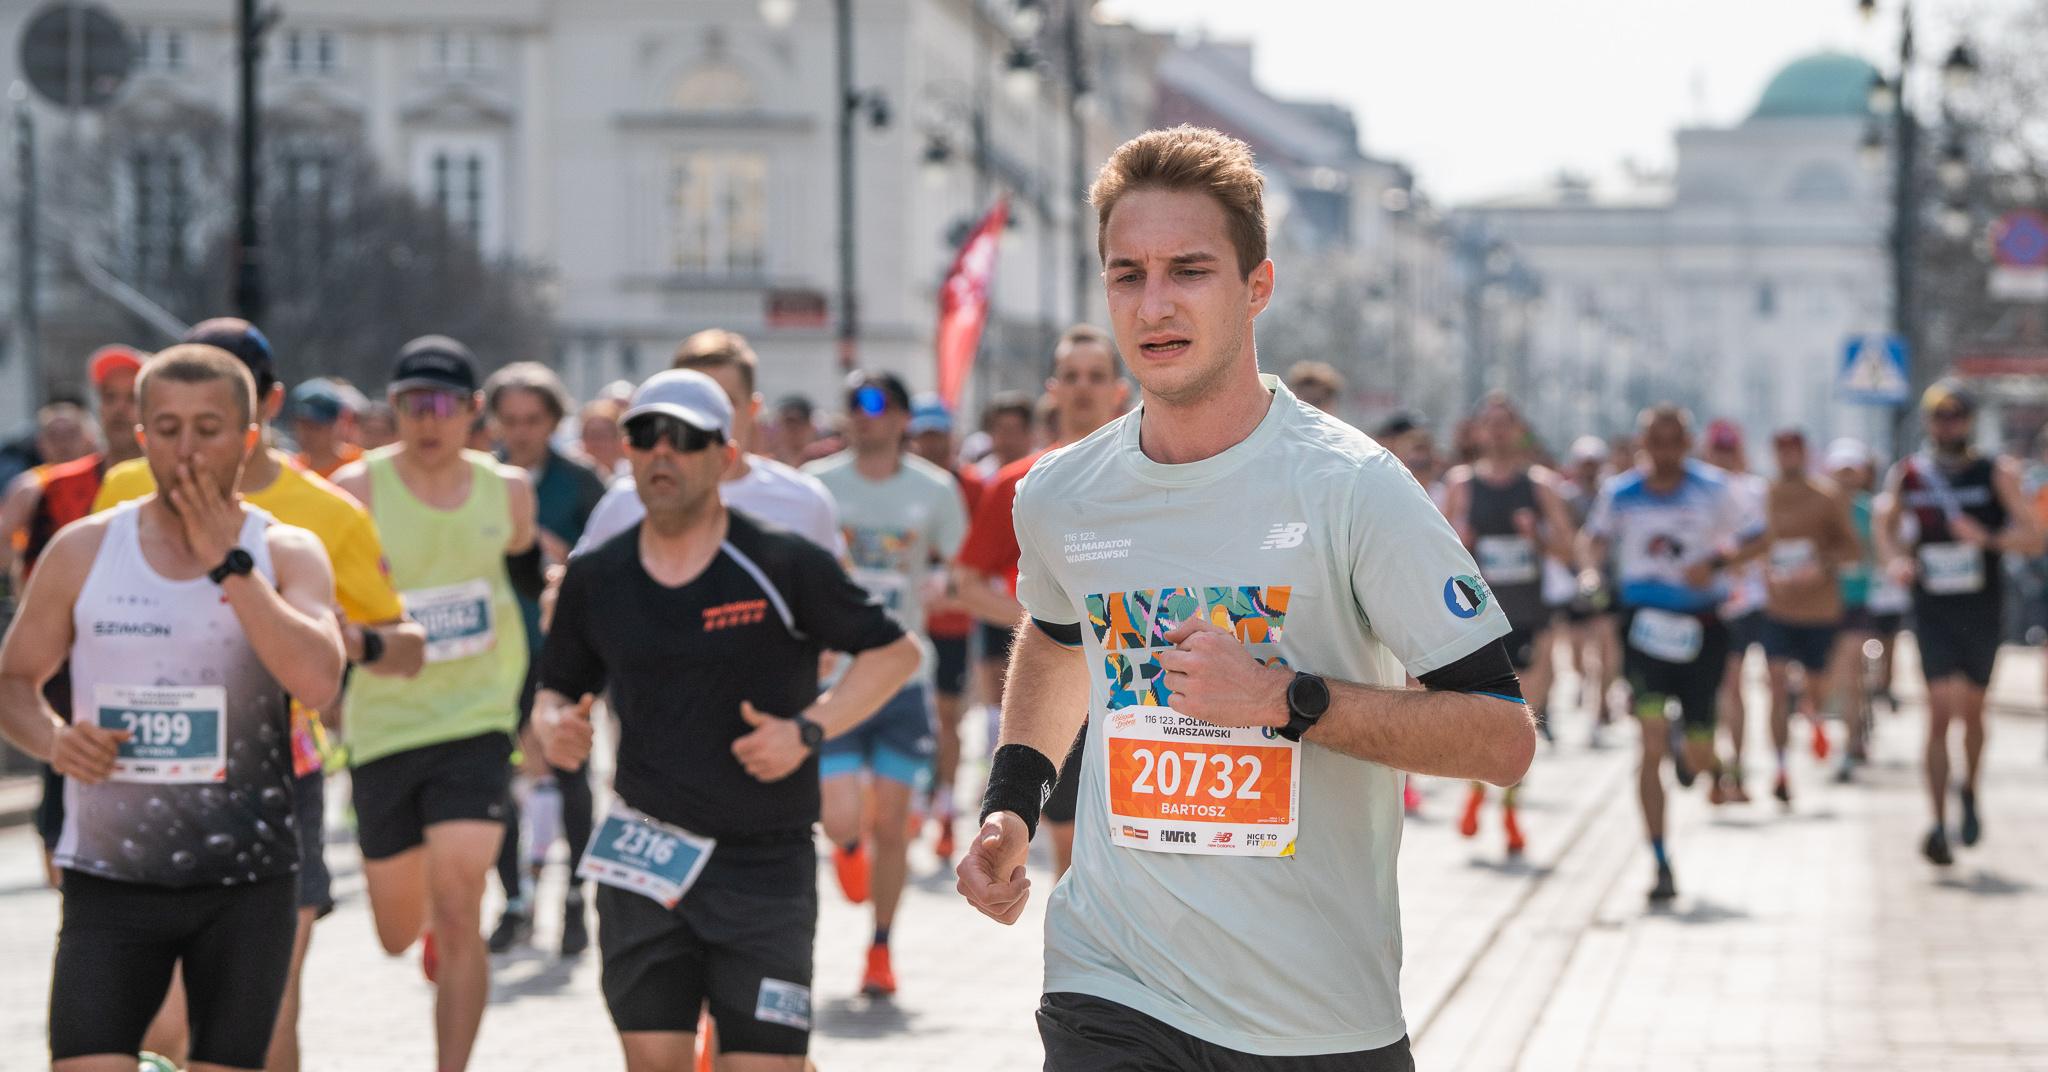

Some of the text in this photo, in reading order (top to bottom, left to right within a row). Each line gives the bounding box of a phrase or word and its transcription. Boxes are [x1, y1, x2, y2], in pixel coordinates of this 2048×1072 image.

[1064, 533, 1078, 542] 116
[1064, 538, 1132, 554] PÓŁMARATON
[1065, 549, 1129, 564] WARSZAWSKI
[120, 710, 192, 746] 2199
[1145, 715, 1157, 724] 116
[1160, 716, 1176, 726] 123.
[1163, 727, 1231, 738] WARSZAWSKI
[1132, 749, 1262, 799] 20732
[1161, 802, 1226, 817] BARTOSZ
[612, 823, 678, 865] 2316
[1260, 840, 1277, 849] you
